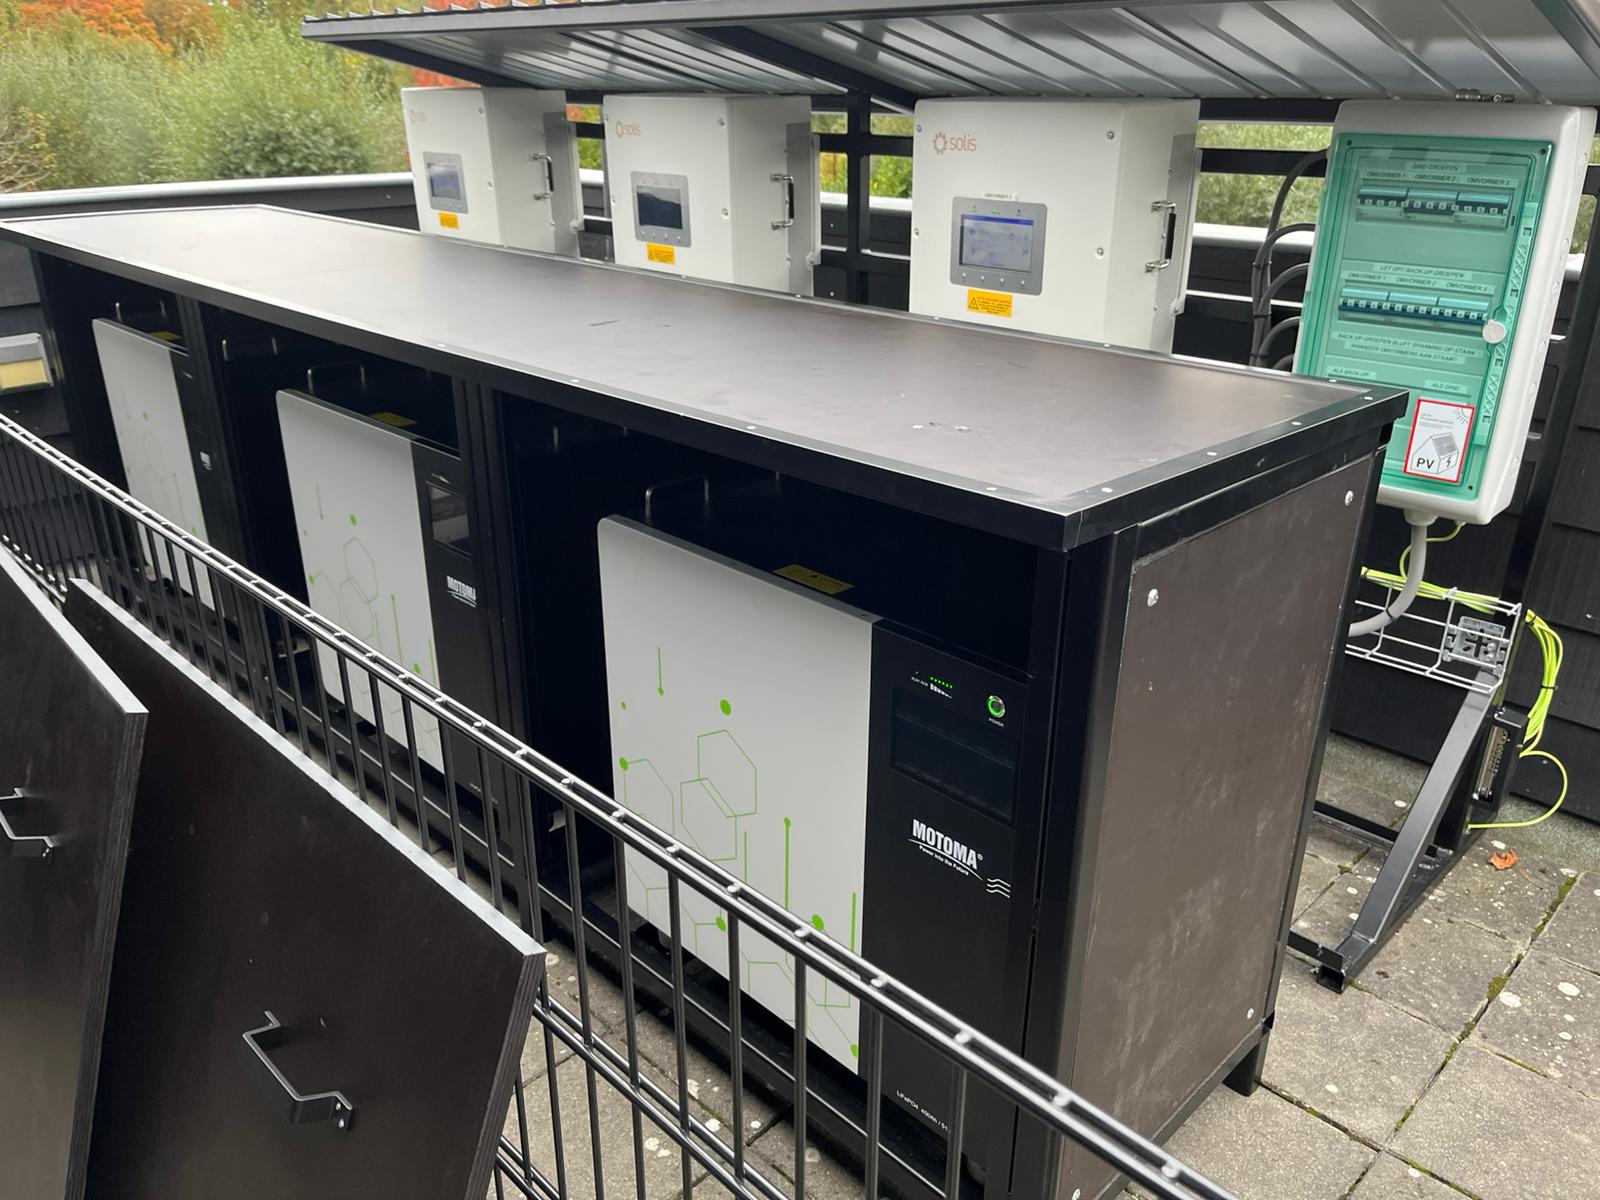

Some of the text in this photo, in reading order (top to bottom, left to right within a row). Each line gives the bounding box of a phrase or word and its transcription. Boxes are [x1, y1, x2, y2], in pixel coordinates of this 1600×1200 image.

[949, 135, 977, 152] solis
[1455, 347, 1475, 356] STAAN
[1416, 457, 1435, 470] PV
